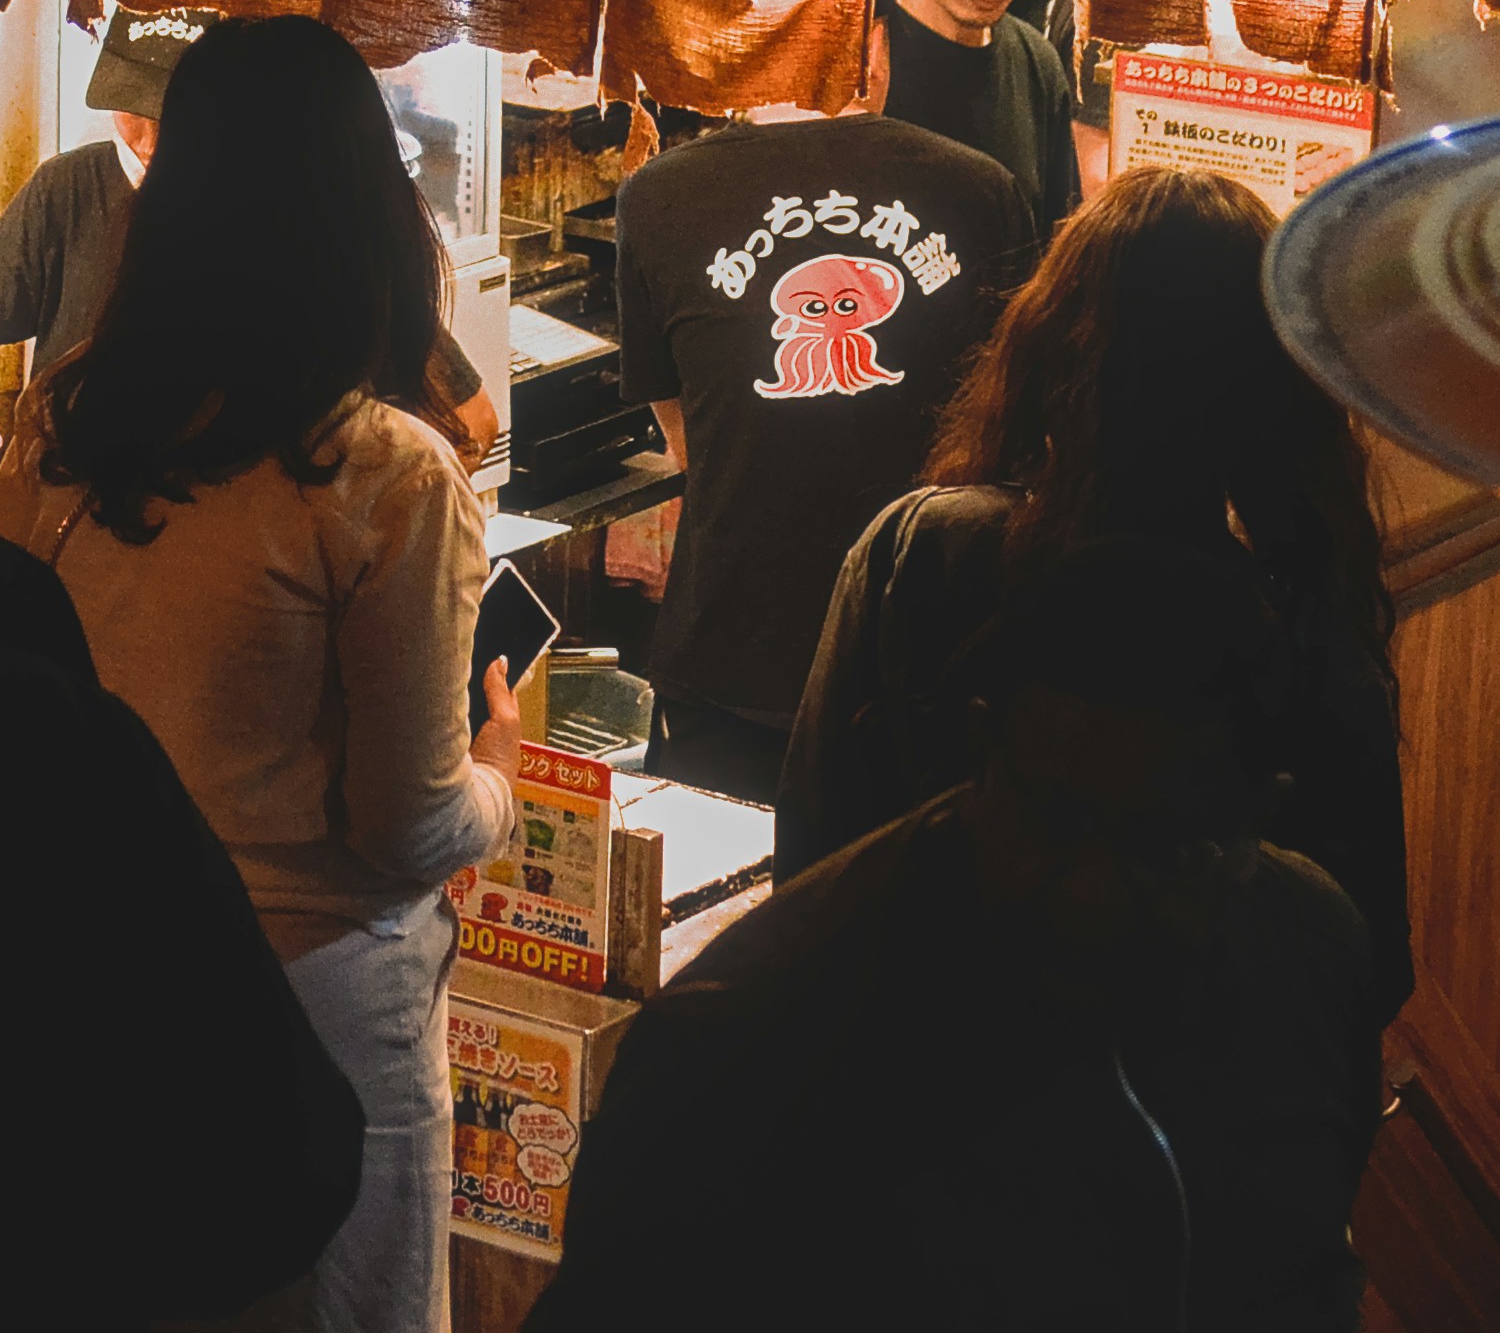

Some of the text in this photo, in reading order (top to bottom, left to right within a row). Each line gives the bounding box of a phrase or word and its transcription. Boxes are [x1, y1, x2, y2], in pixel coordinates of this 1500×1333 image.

[1135, 107, 1158, 122] その
[1163, 118, 1288, 153] 鉄板のこだわり!
[706, 188, 962, 300] あっちち本舗
[554, 758, 601, 791] セット
[511, 910, 589, 949] あっちち本舗
[471, 1203, 551, 1243] あっちち本舗
